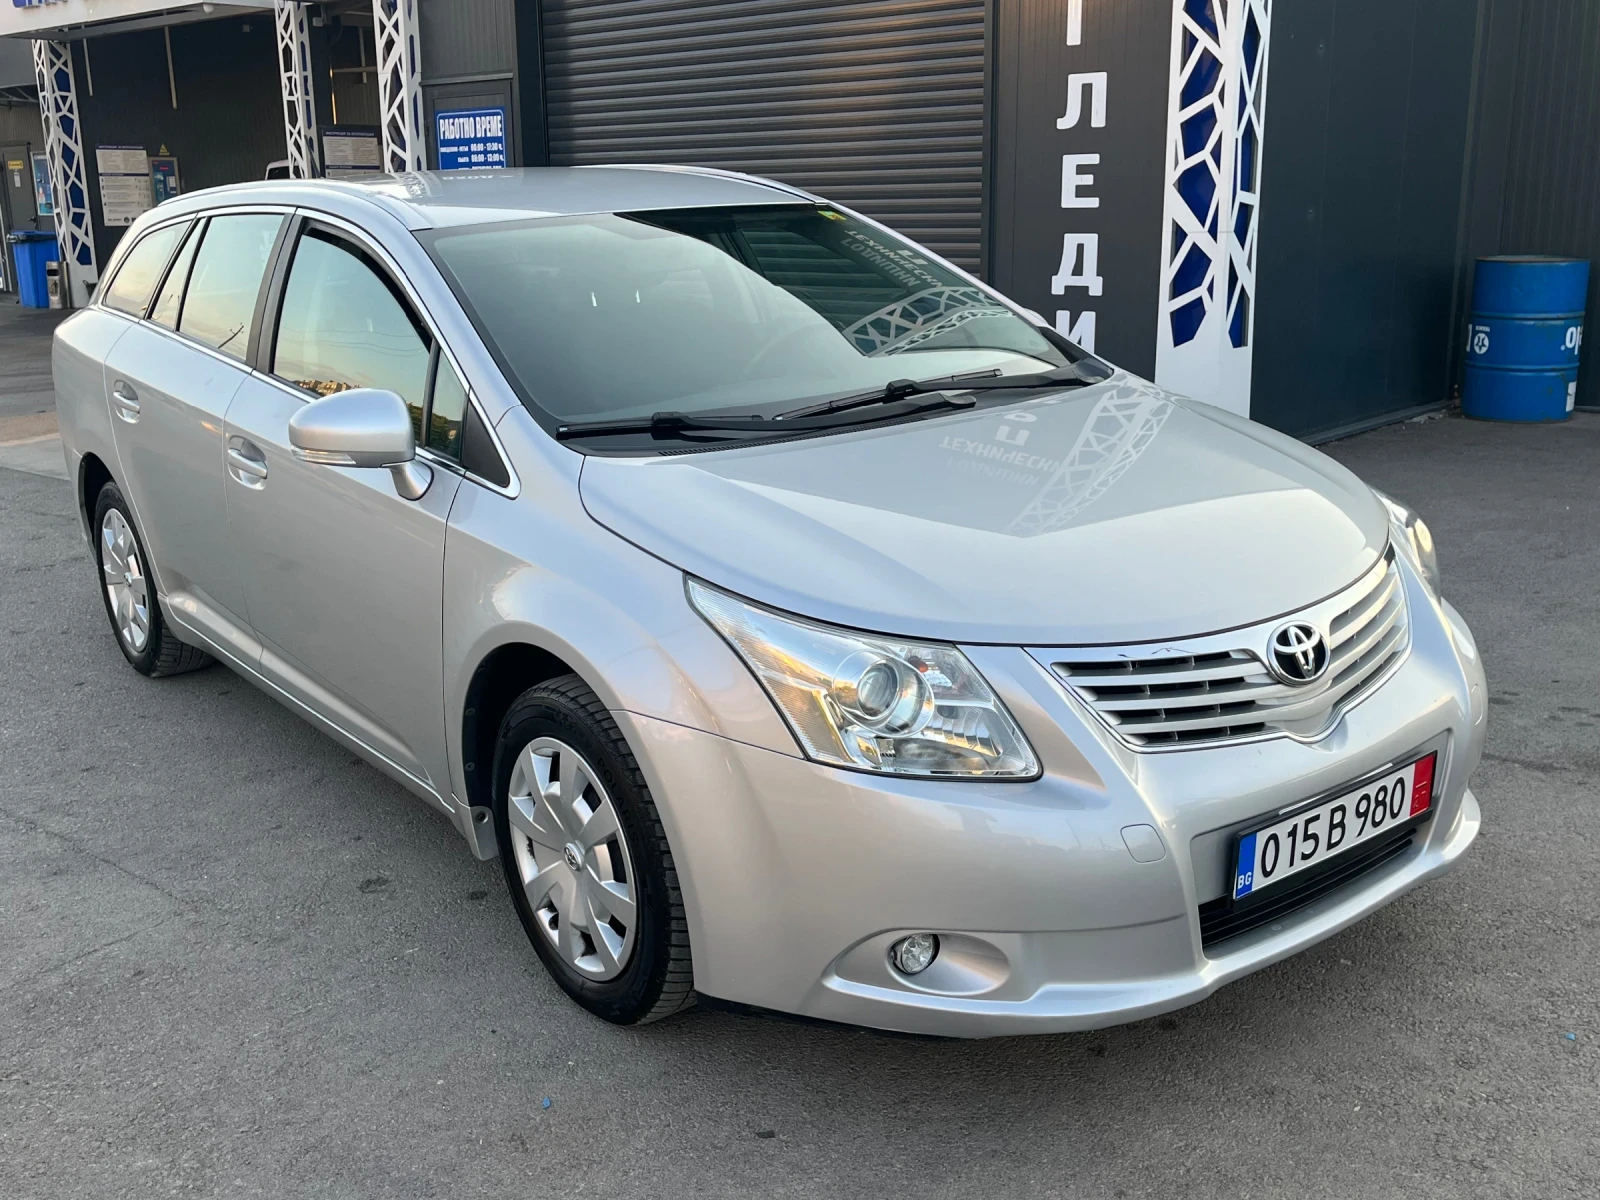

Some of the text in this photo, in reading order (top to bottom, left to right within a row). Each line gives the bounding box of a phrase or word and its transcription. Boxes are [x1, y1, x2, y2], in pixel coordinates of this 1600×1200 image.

[439, 115, 503, 140] РАБОТНО ВРЕМЕ
[1237, 871, 1252, 889] BG
